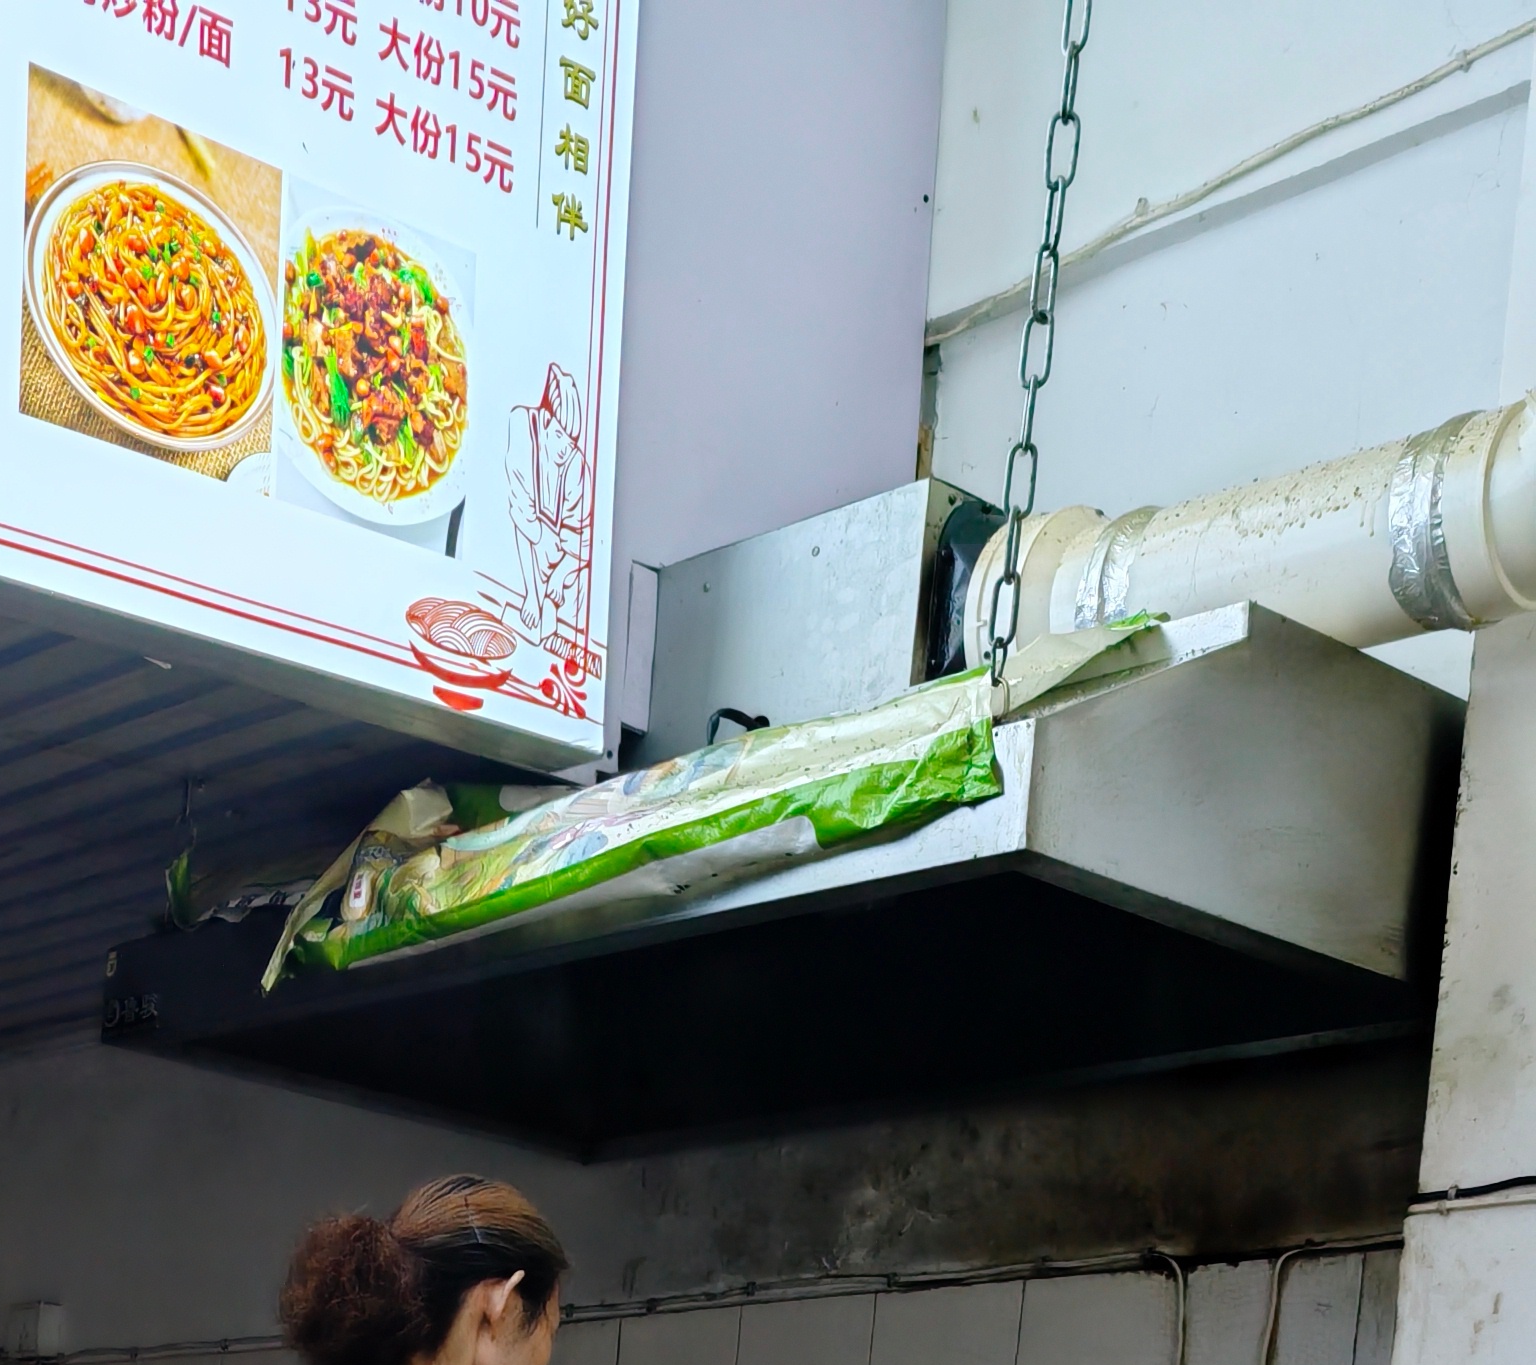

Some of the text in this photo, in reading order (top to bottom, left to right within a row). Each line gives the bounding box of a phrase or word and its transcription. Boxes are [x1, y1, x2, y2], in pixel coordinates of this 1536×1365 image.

[279, 47, 515, 194] 13元 大份15元
[378, 16, 518, 122] 大份15元
